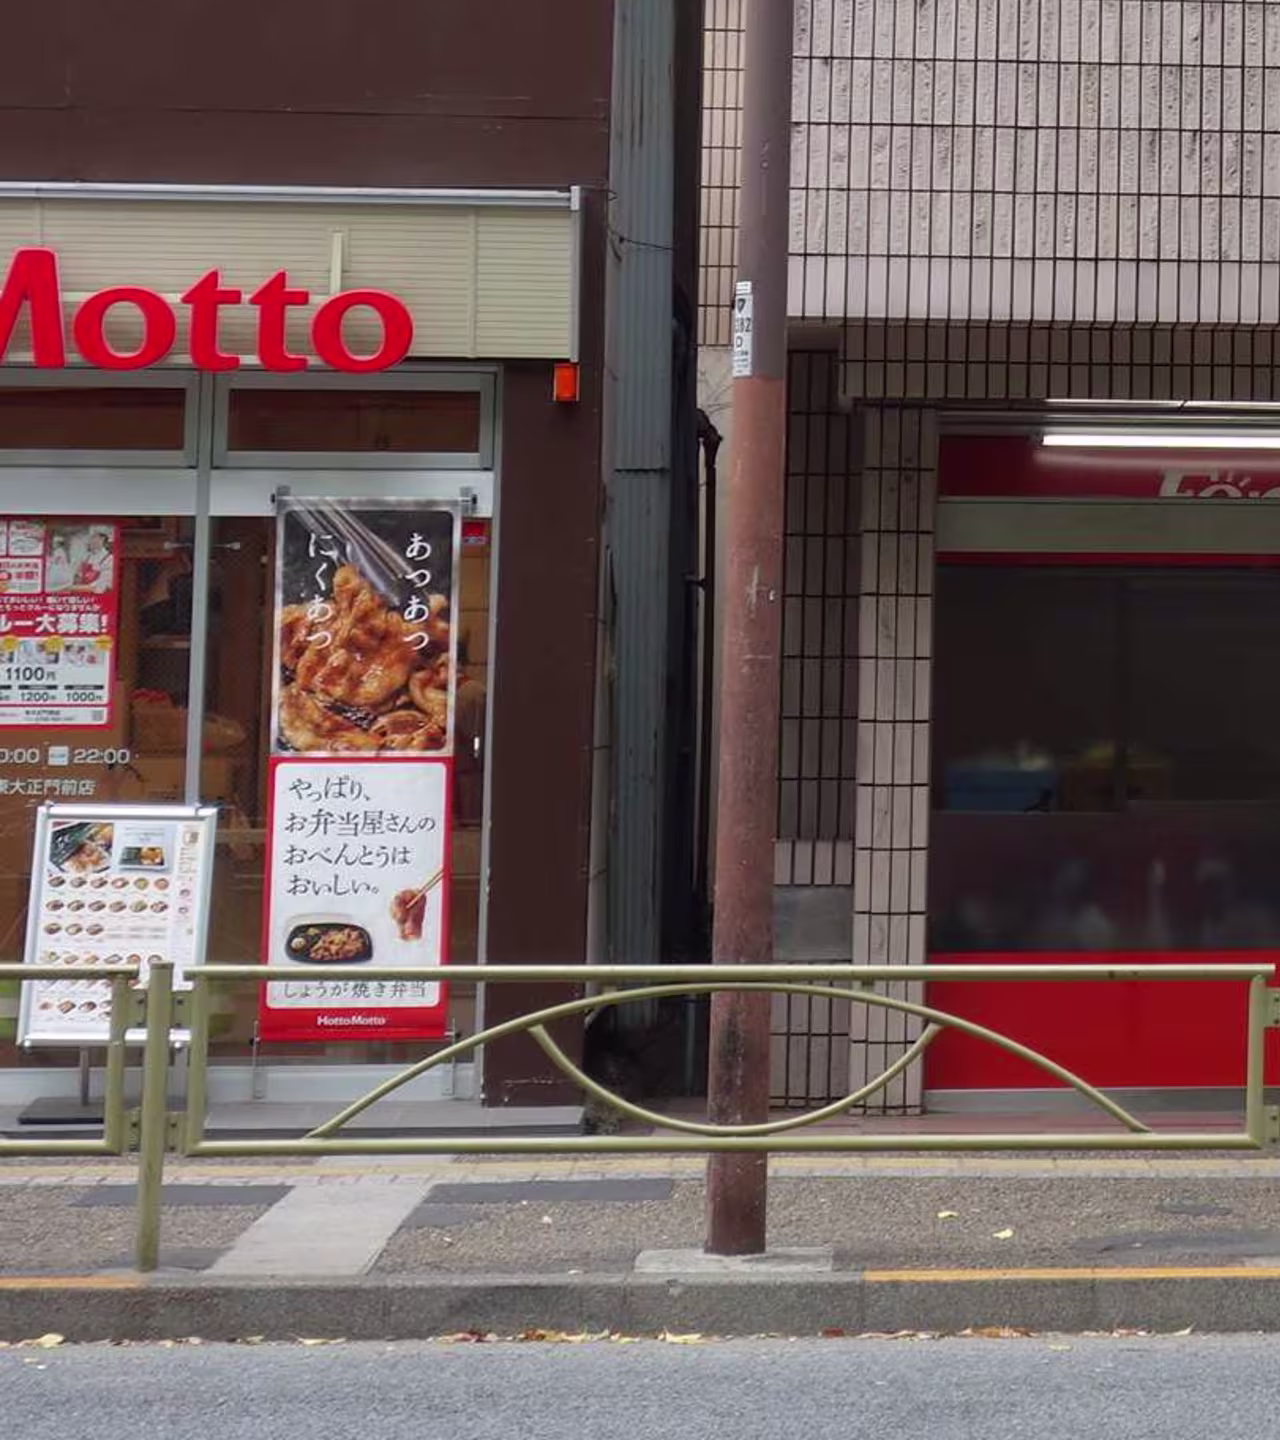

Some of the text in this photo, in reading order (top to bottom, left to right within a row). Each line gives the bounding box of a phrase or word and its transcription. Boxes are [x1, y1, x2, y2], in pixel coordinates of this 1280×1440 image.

[306, 532, 338, 649] にくあつ
[403, 532, 432, 651] あつあつ
[73, 748, 131, 764] 22:00
[288, 775, 372, 802] やっぱり、
[283, 808, 437, 838] お弁当屋さんの
[283, 843, 412, 867] おべんとうは
[286, 873, 380, 897] おいしい。
[283, 980, 427, 1000] しょうが焼き弁当
